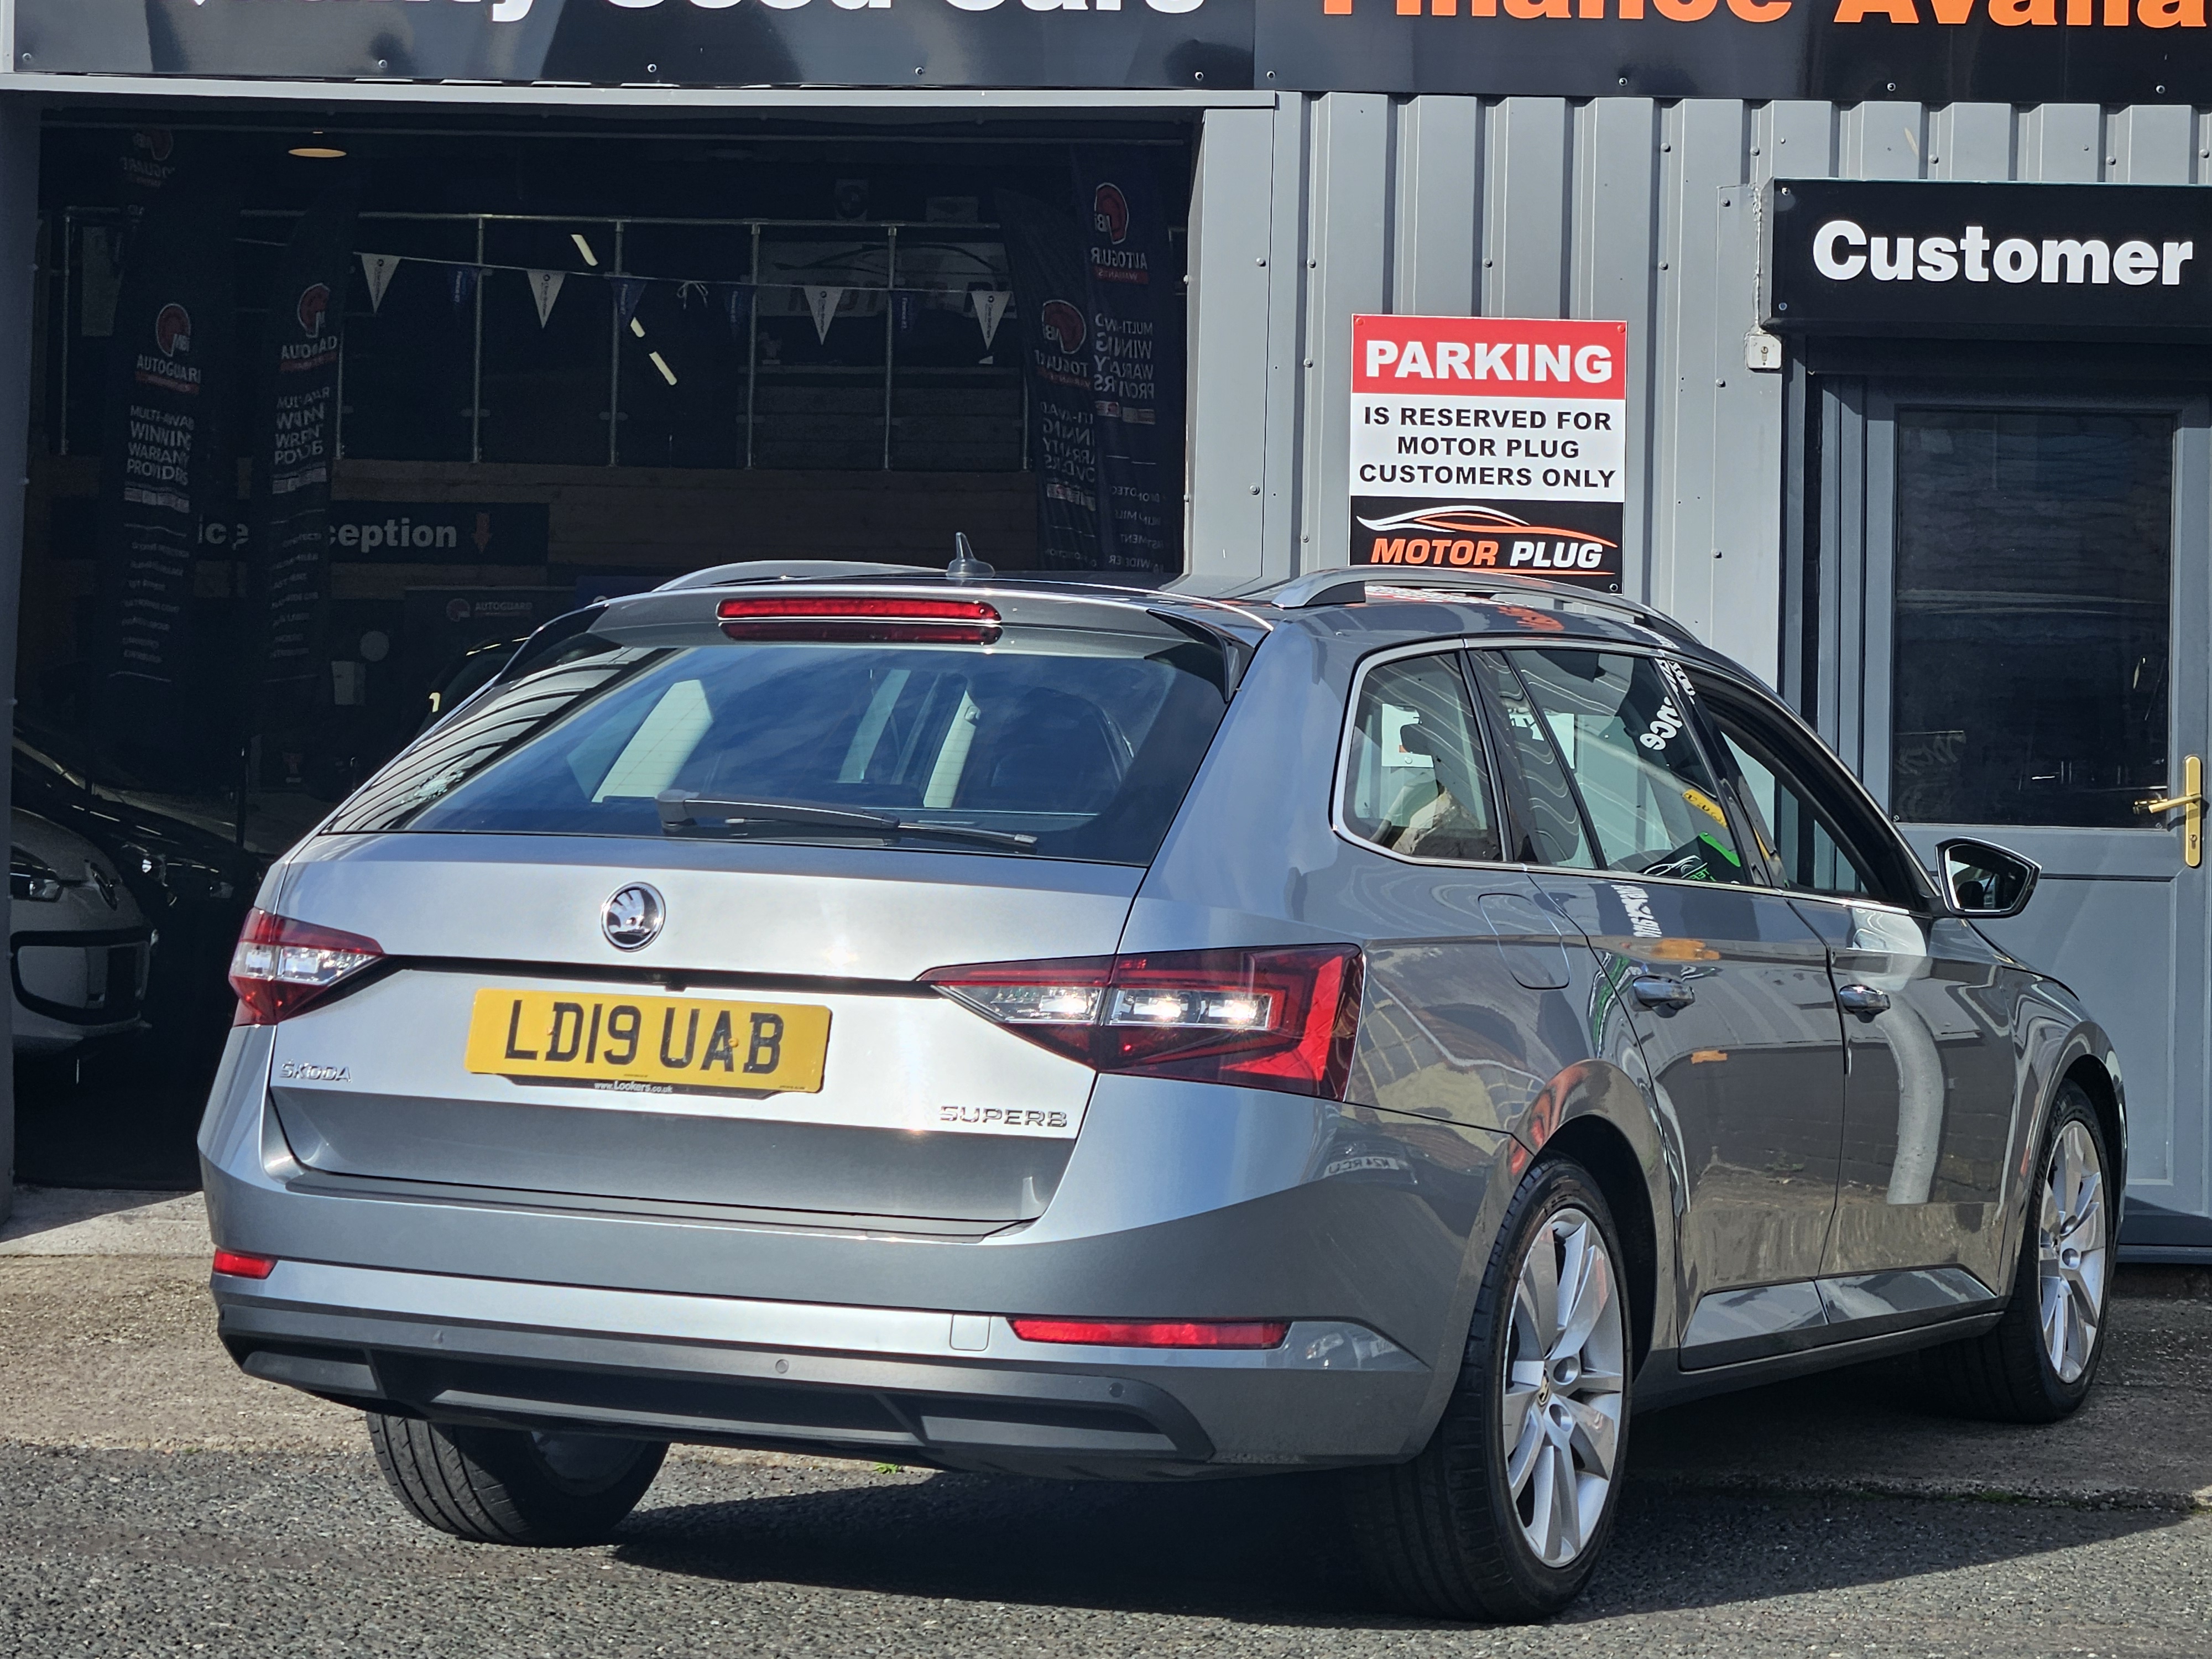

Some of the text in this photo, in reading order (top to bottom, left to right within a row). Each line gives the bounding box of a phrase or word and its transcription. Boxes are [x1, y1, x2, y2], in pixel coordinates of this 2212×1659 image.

[1812, 220, 2193, 285] Customer
[1366, 340, 1612, 384] PARKING
[1364, 406, 1612, 431] IS RESERVED FOR
[1397, 436, 1579, 458] MOTOR PLUG
[1359, 464, 1616, 488] CUSTOMERS ONLY
[1370, 538, 1603, 568] MOTOR PLUG
[474, 601, 534, 611] AUTOGUARD
[504, 999, 784, 1075] LD19 UAB
[594, 1080, 673, 1094] www.Lookers.co.uk
[938, 1105, 1068, 1128] SUPERB
